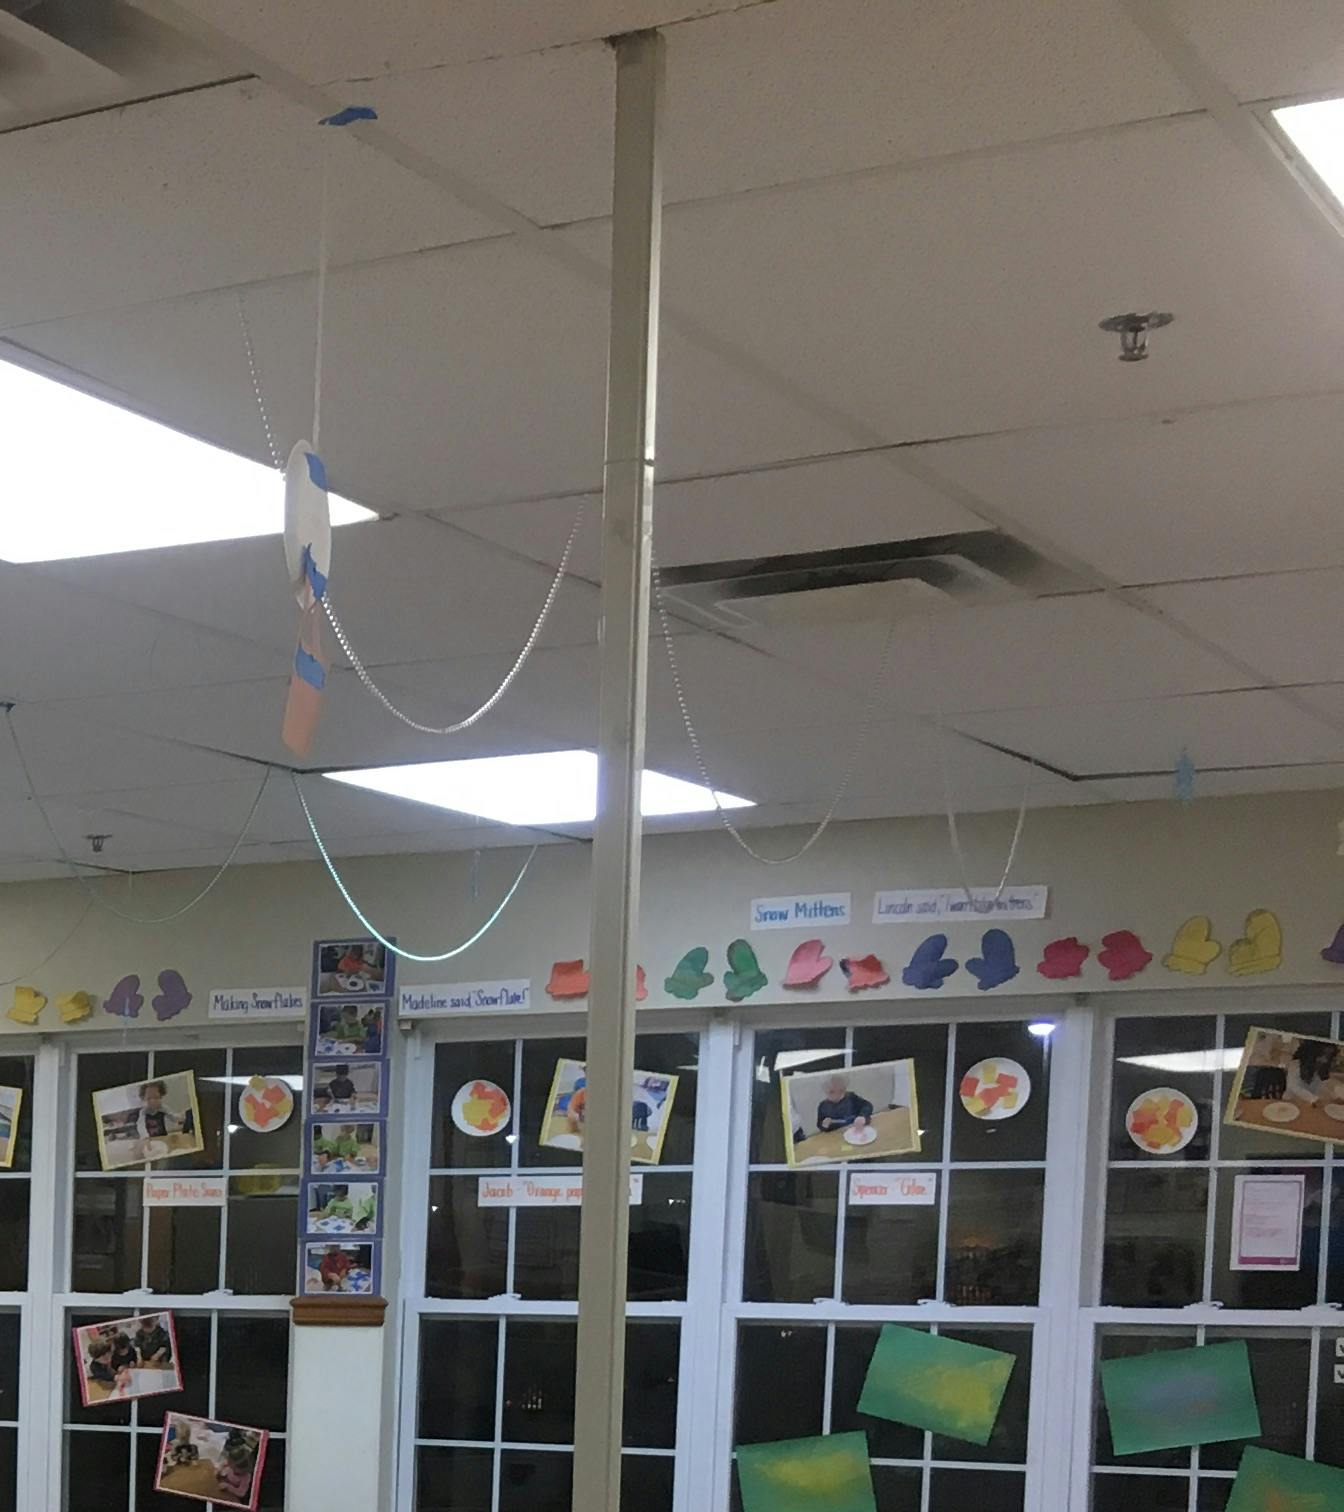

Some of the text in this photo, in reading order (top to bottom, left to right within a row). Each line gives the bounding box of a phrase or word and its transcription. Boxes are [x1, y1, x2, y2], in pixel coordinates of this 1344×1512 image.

[755, 900, 846, 923] Snow Mittens
[214, 992, 303, 1014] Making Snowflakes
[402, 993, 448, 1010] Madeline
